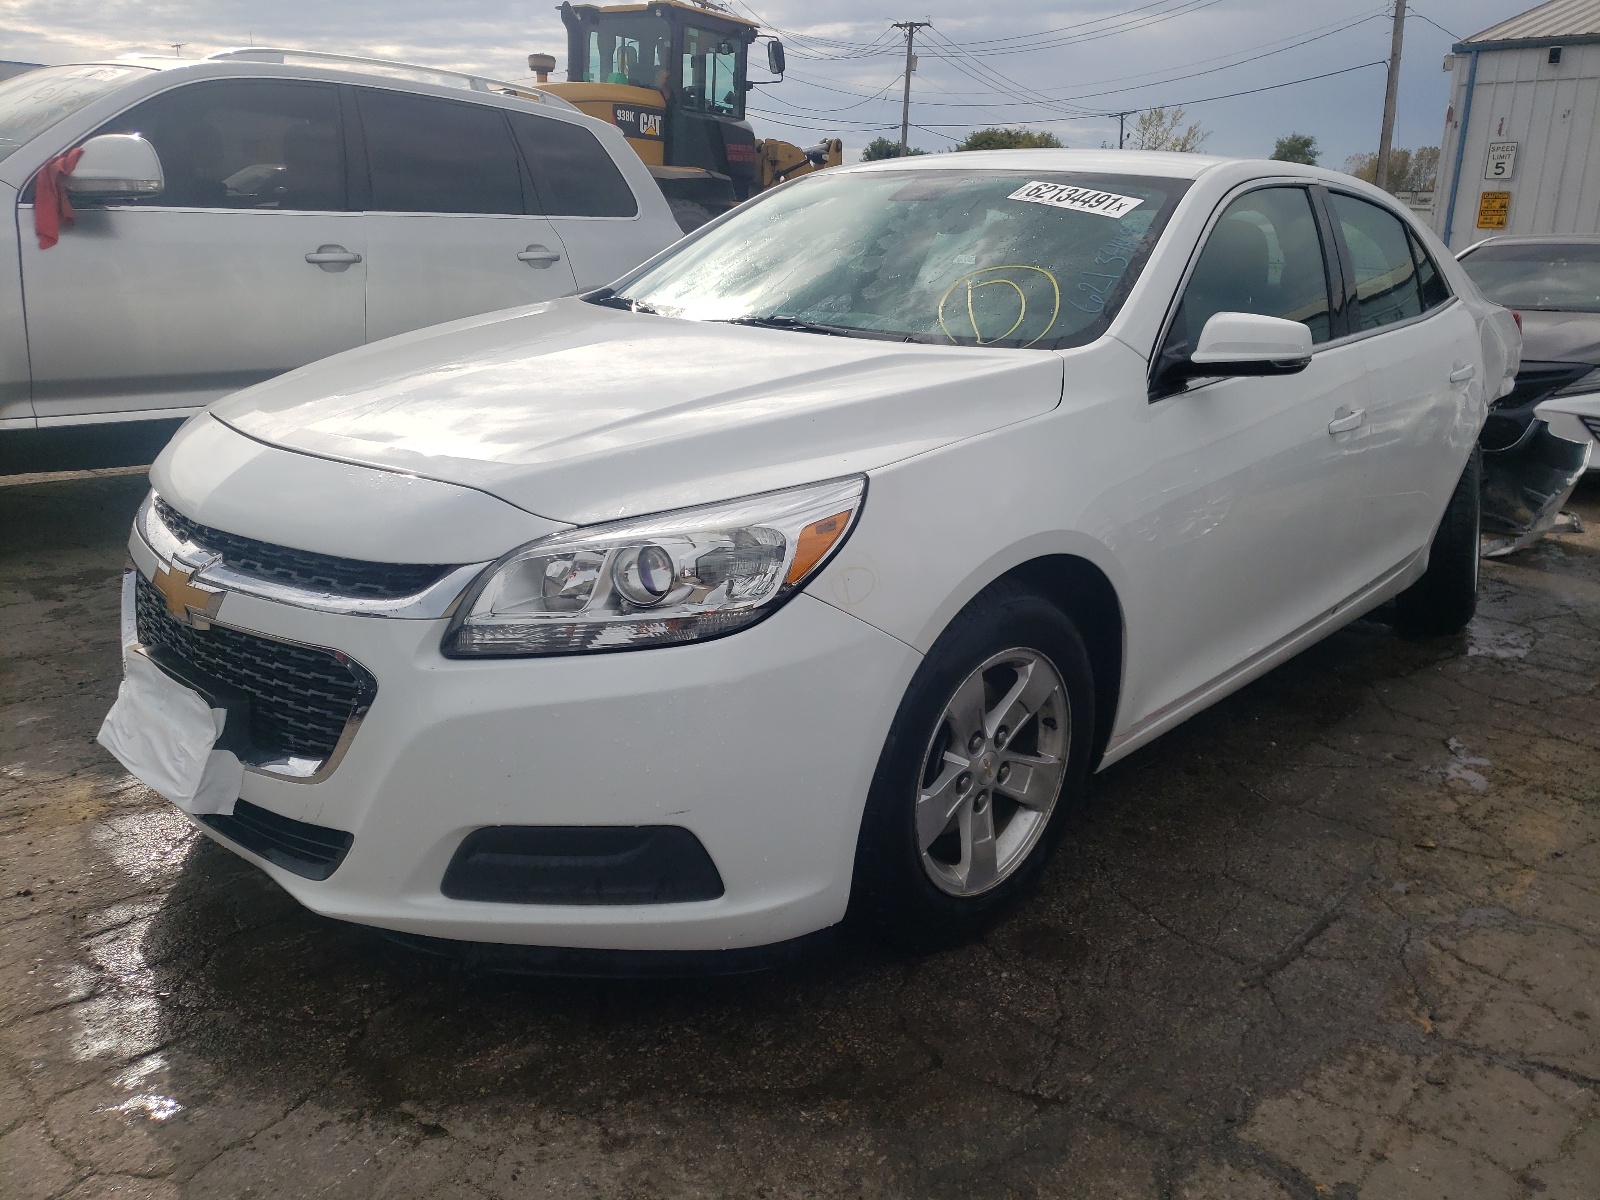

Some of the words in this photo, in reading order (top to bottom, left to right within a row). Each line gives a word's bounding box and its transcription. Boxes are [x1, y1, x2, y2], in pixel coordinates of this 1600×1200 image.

[617, 109, 635, 122] 938K
[640, 112, 661, 136] CAT
[1494, 161, 1506, 176] 5
